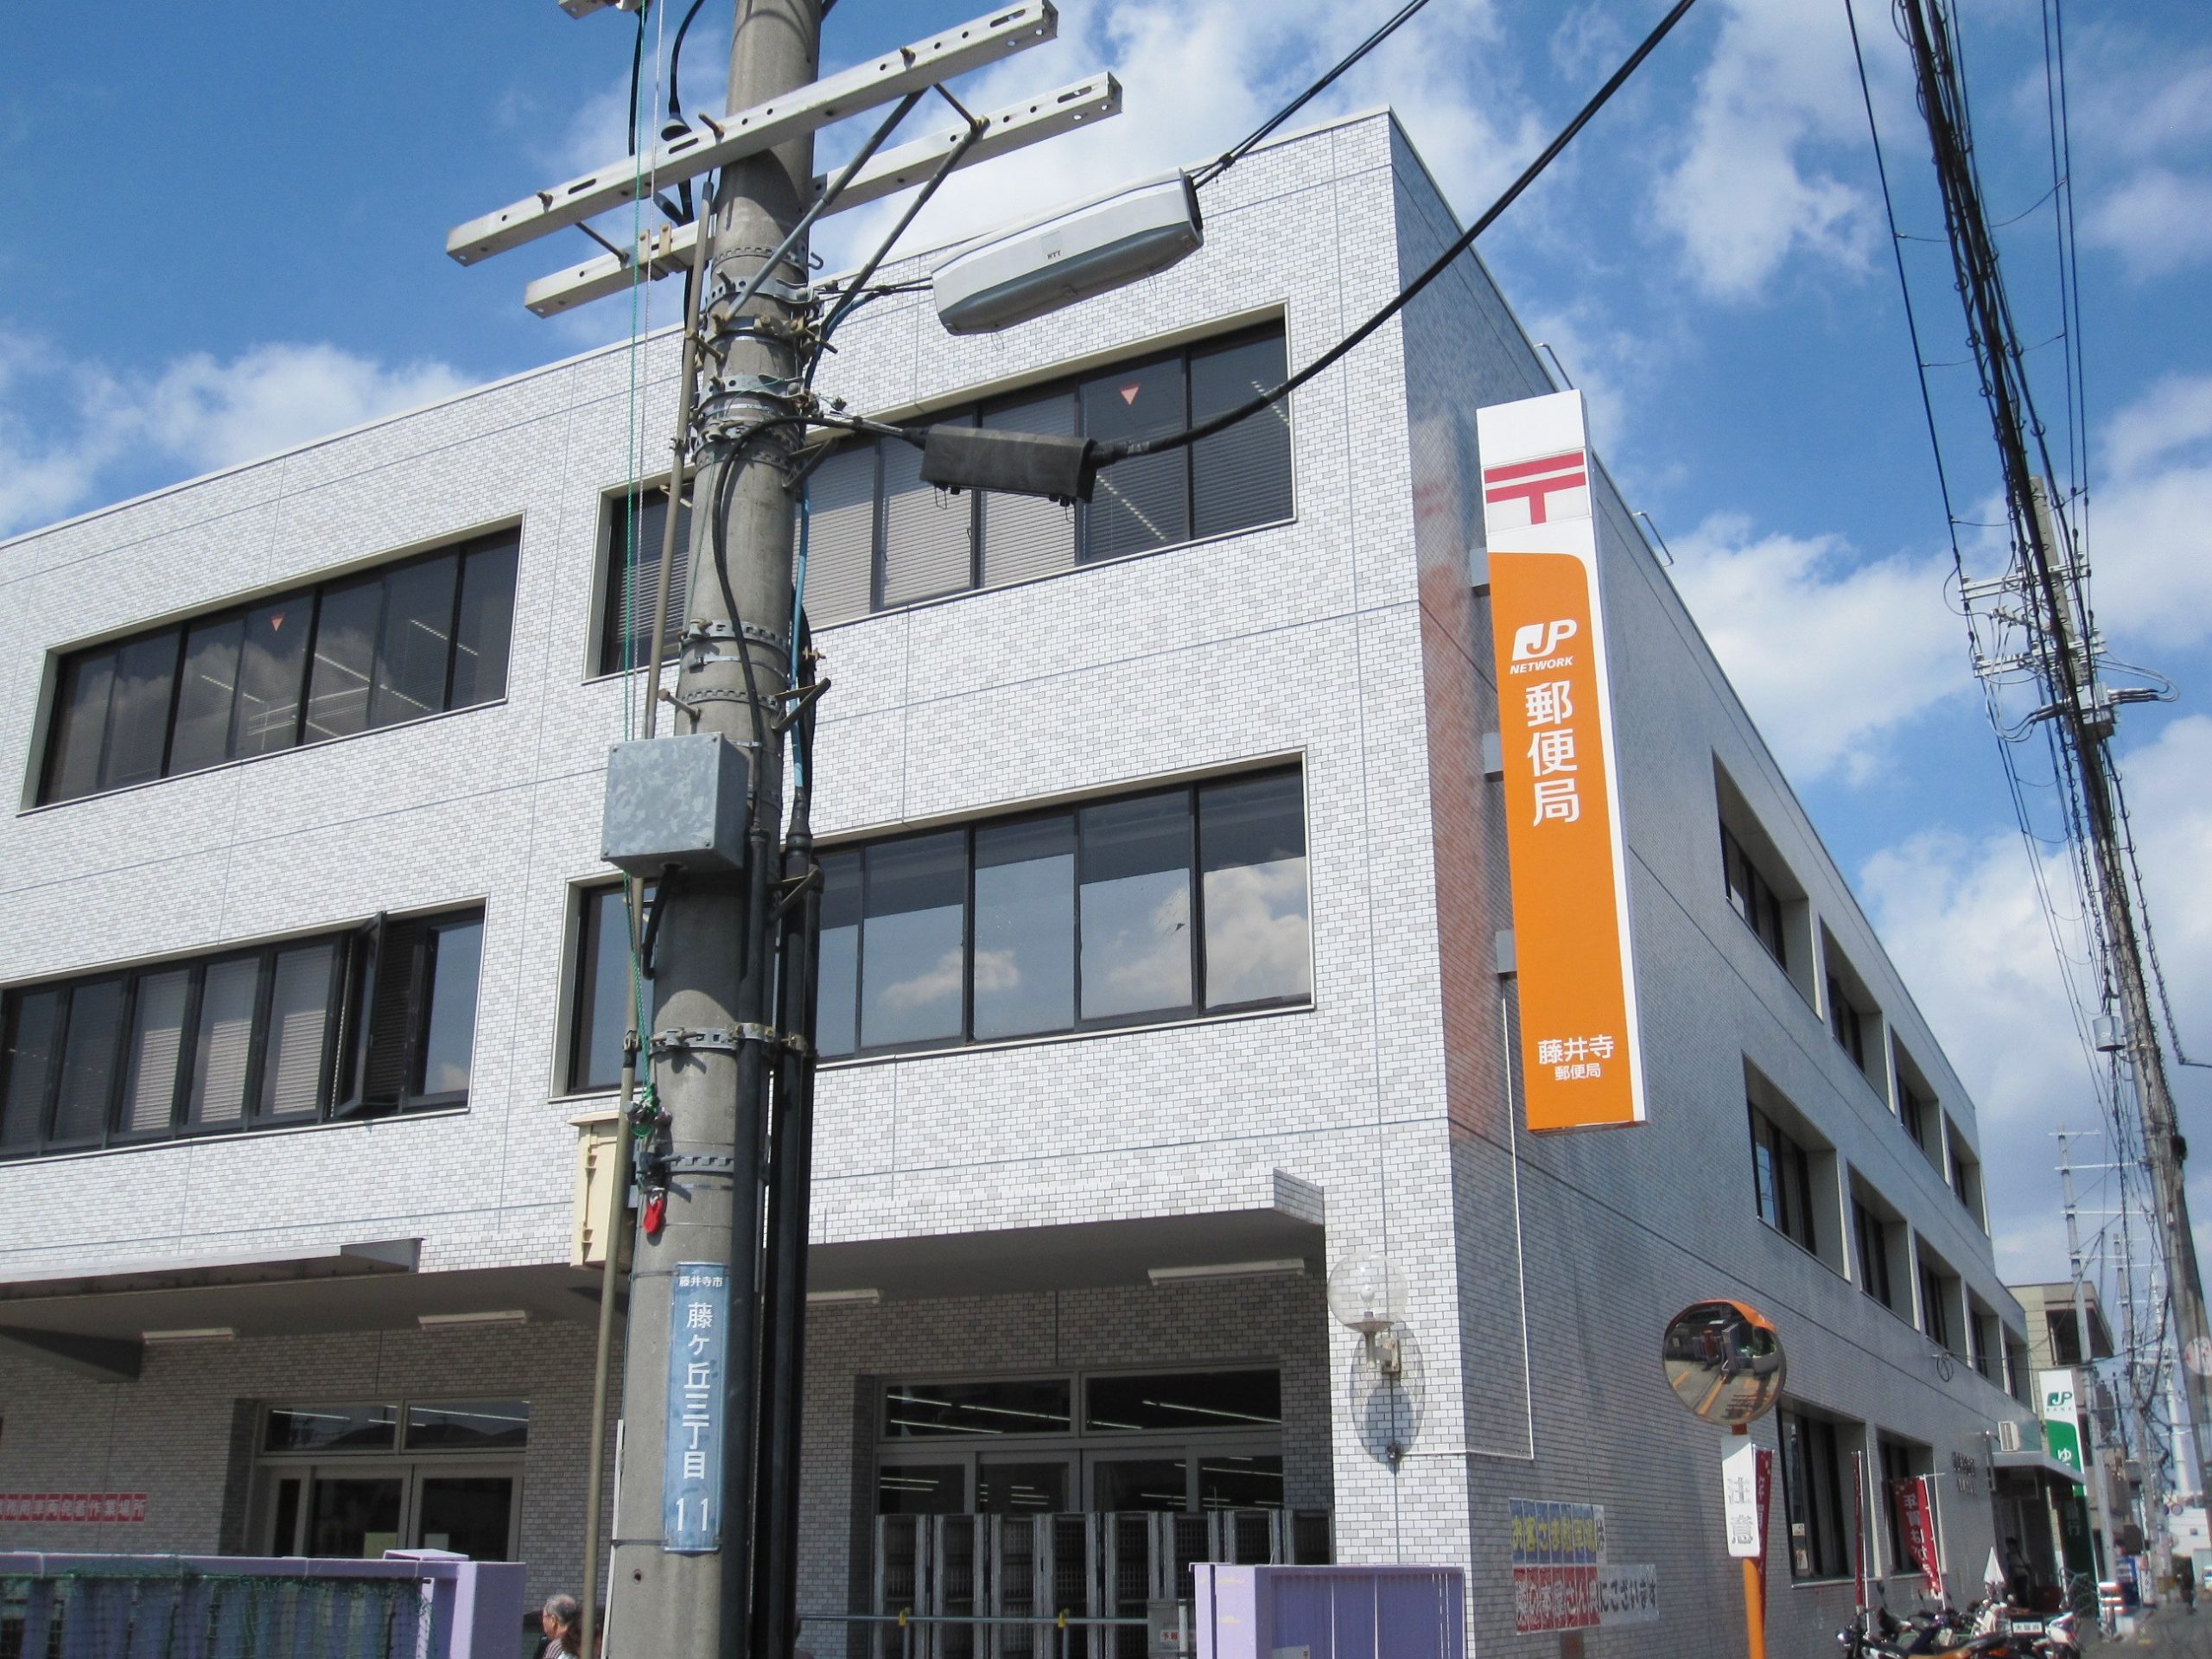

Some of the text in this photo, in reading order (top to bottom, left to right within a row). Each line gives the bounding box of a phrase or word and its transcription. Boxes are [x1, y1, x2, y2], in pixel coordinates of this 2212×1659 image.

[1512, 619, 1578, 661] JP
[1510, 656, 1573, 674] NETWORK
[1525, 680, 1580, 827] 郵便局
[1537, 1035, 1615, 1065] 藤井寺
[1554, 1062, 1601, 1081] 郵便局
[678, 1275, 724, 1287] 藤井寺市
[2047, 1391, 2073, 1407] JP
[675, 1497, 711, 1533] 11
[1726, 1476, 1756, 1547] 注意
